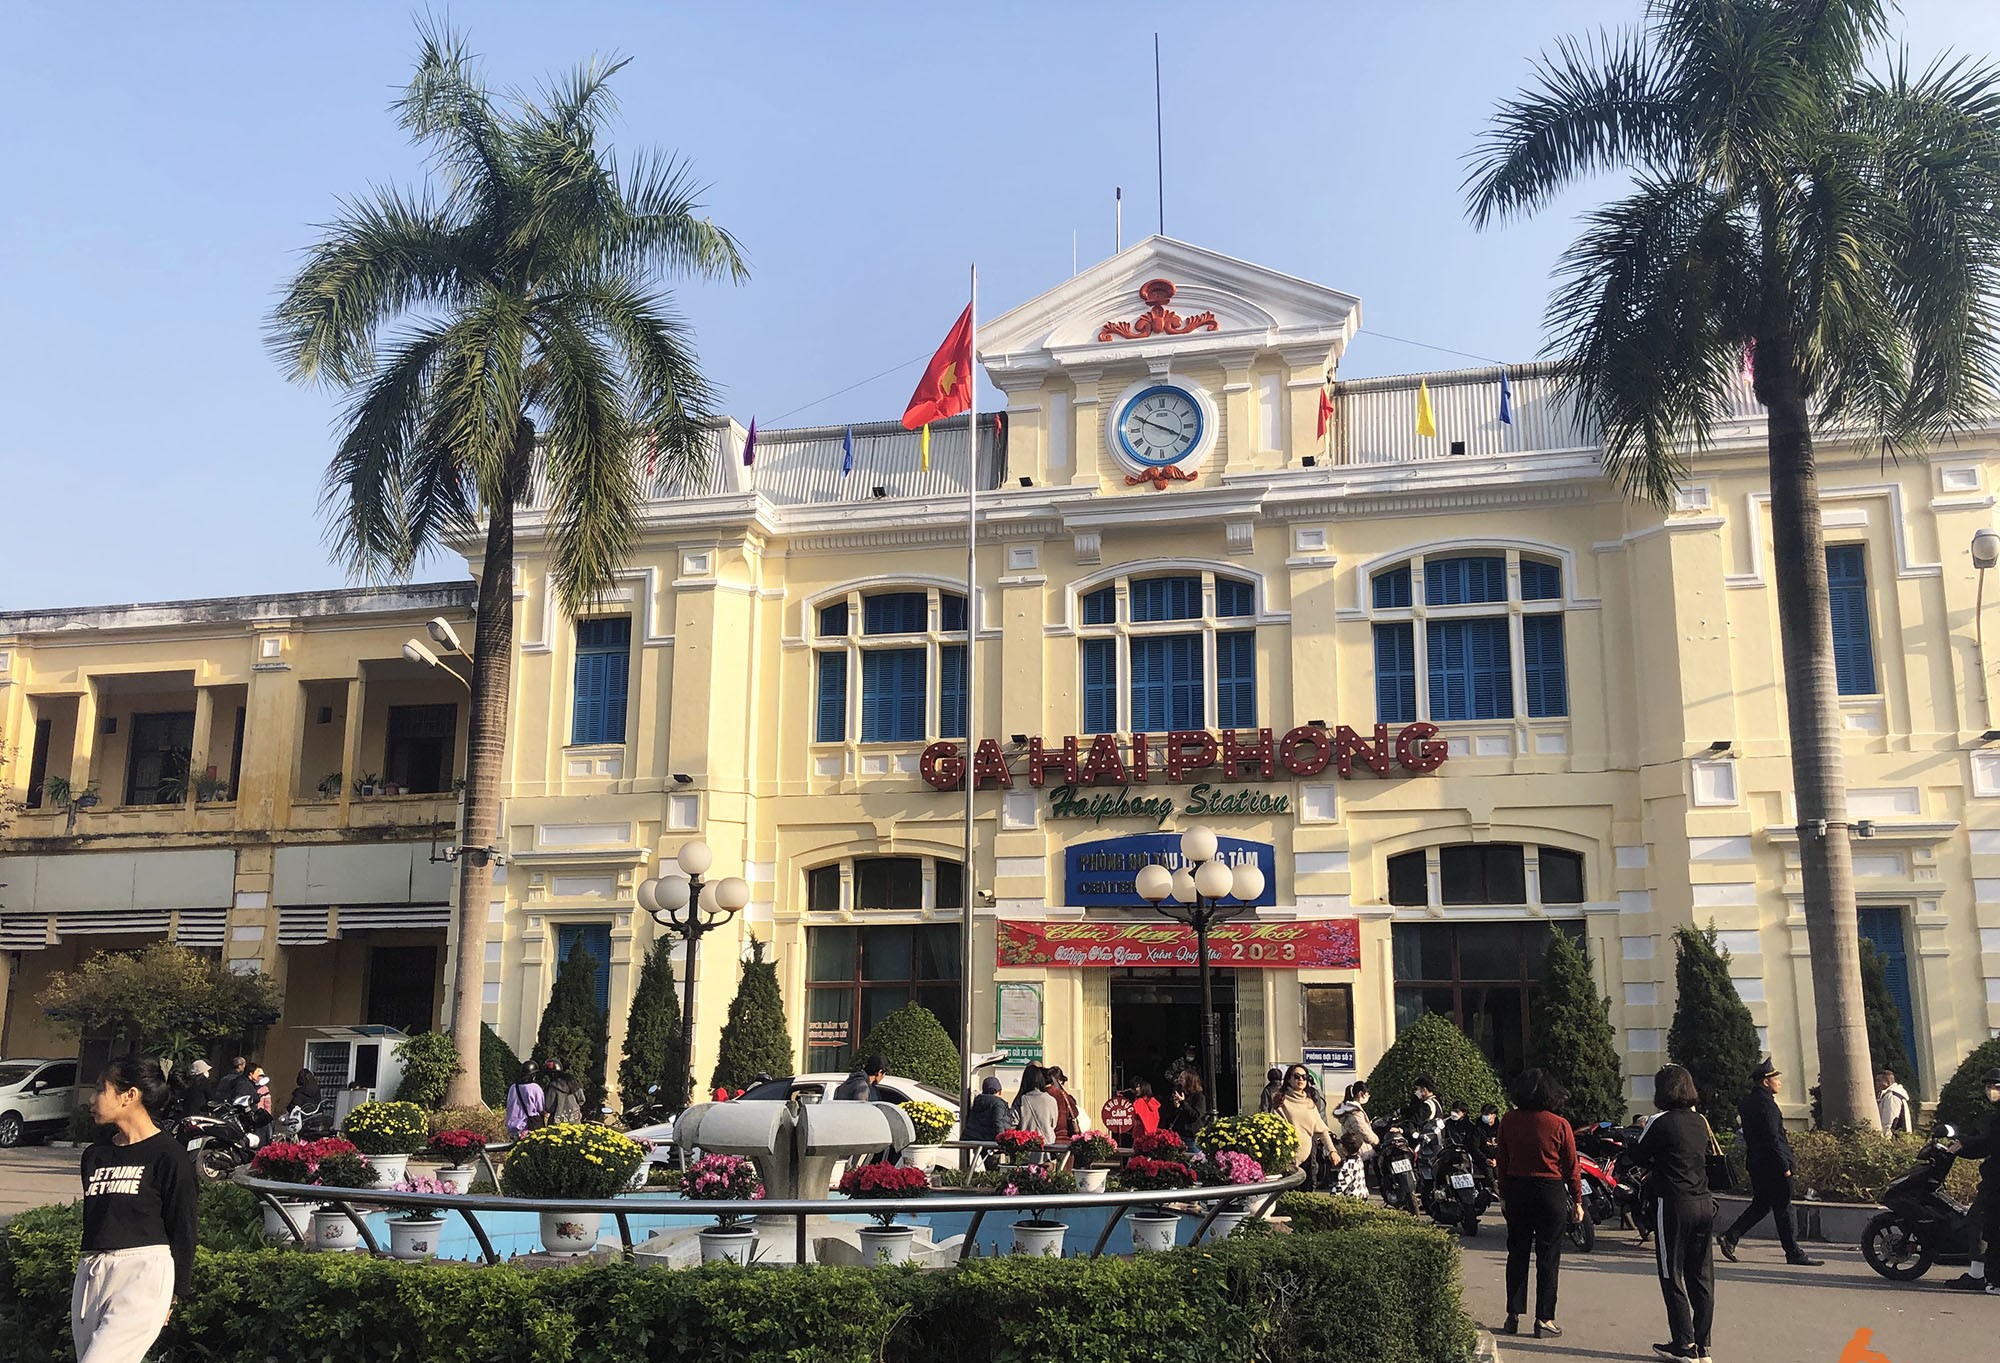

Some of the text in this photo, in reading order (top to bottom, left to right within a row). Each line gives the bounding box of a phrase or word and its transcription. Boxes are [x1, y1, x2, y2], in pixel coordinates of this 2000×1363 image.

[920, 722, 1449, 790] GA HAI PHONG
[1050, 783, 1290, 824] Haiphong Station
[1229, 847, 1258, 869] TÂM
[1043, 923, 1109, 941] Chúc
[1054, 945, 1087, 965] Happy
[1088, 945, 1113, 961] New
[1114, 945, 1142, 965] Year
[1146, 945, 1173, 963] Xuân
[1231, 943, 1296, 961] 2023
[1104, 1099, 1119, 1111] KHU
